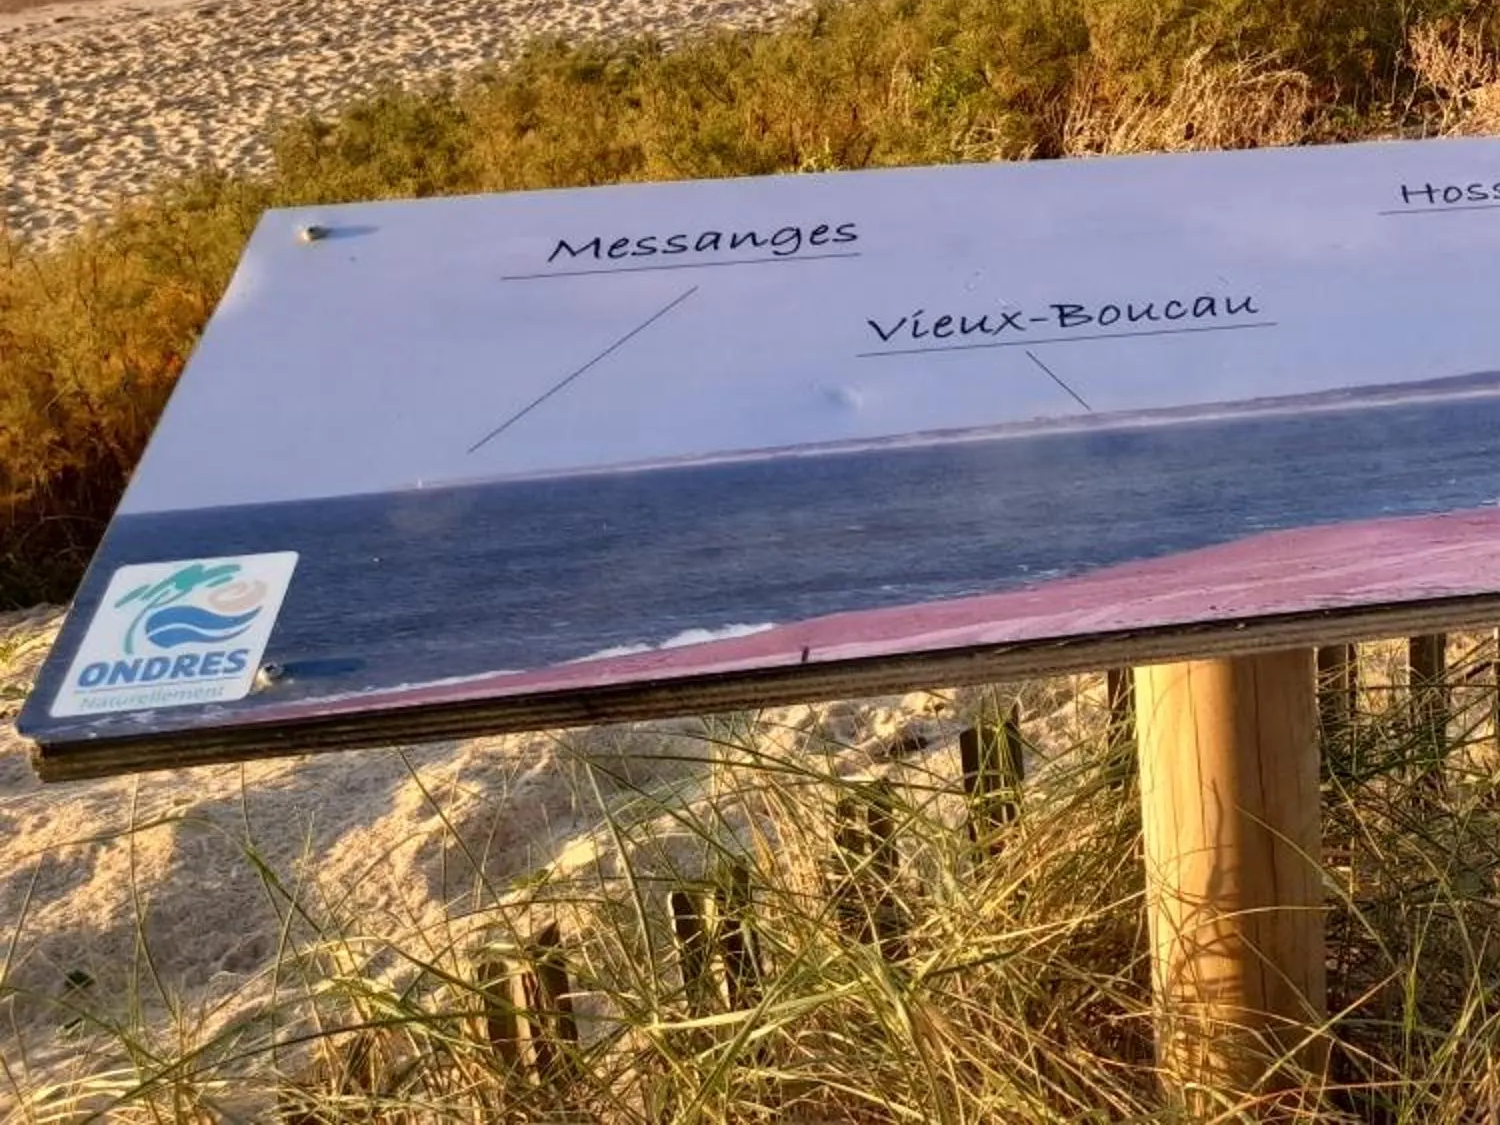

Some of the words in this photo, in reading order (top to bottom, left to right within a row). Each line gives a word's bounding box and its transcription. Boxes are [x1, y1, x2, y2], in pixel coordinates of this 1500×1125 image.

[547, 221, 858, 263] Messanges
[867, 293, 1259, 342] Vieux-Boucau
[78, 648, 251, 688] ONDRES
